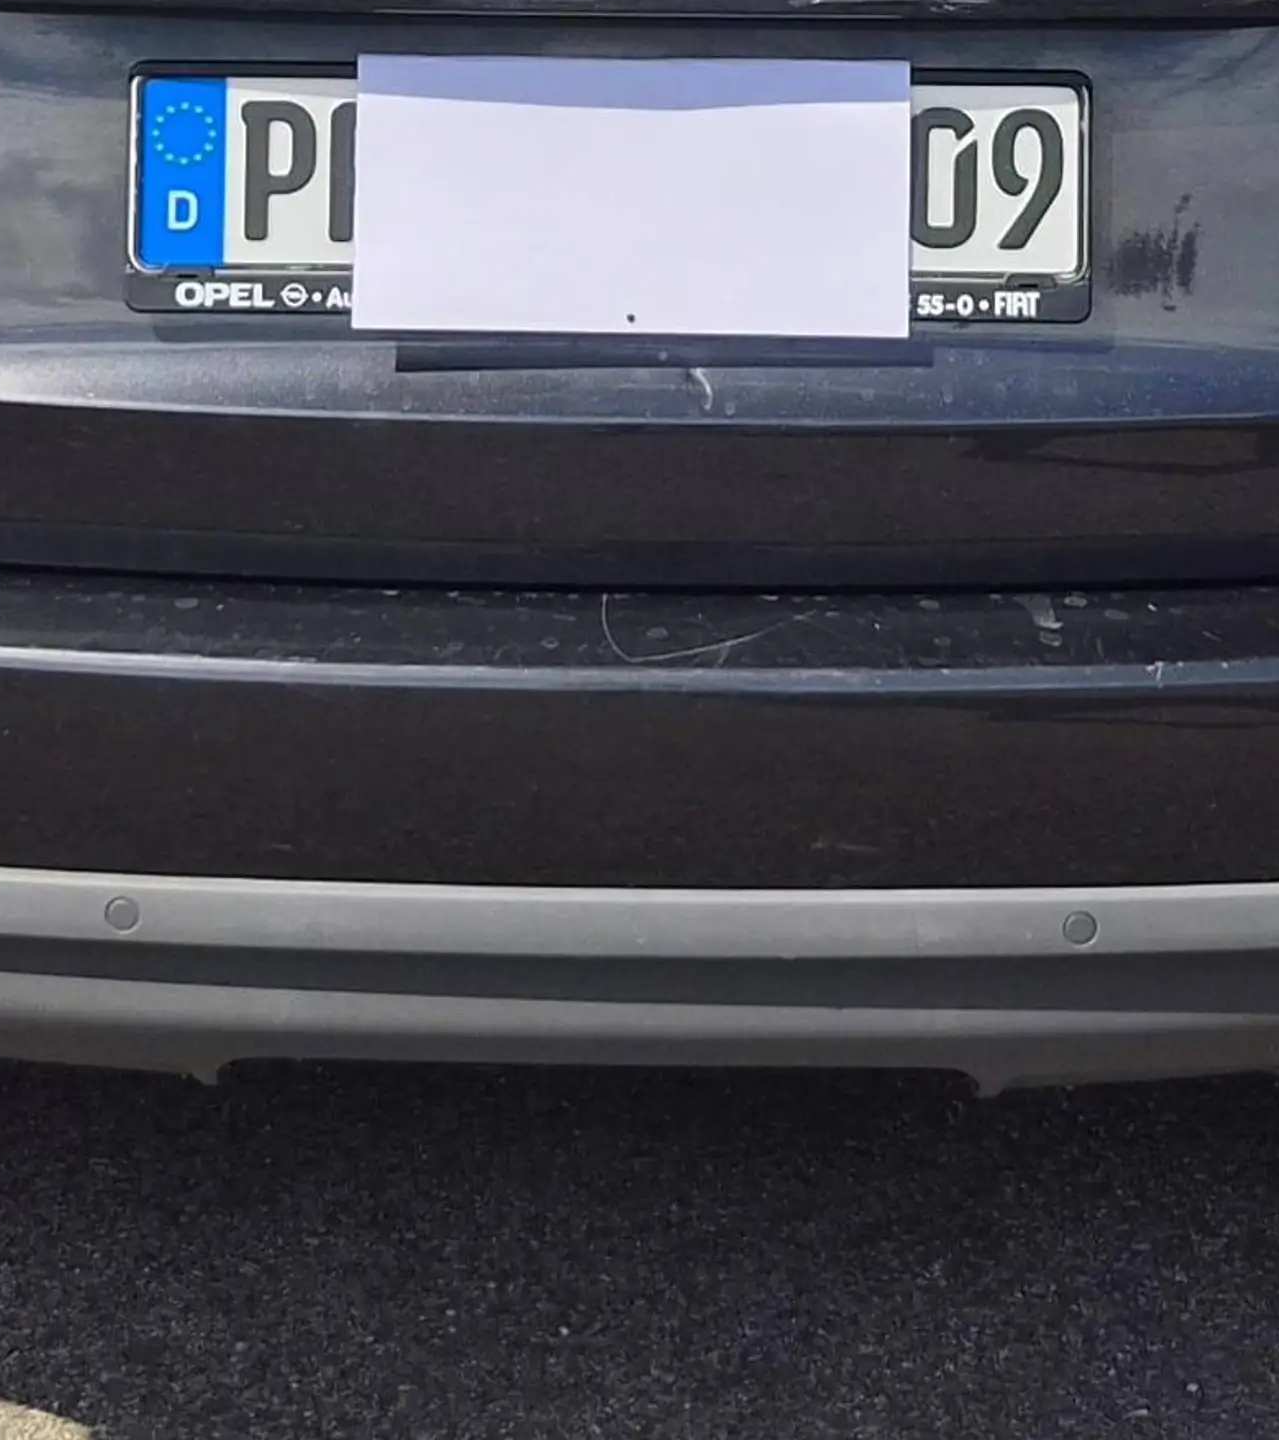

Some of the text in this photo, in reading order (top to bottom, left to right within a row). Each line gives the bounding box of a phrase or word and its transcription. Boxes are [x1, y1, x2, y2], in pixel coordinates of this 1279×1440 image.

[241, 100, 355, 242] P
[167, 190, 198, 230] D
[175, 282, 275, 308] OPEL
[994, 291, 1041, 317] FIAT
